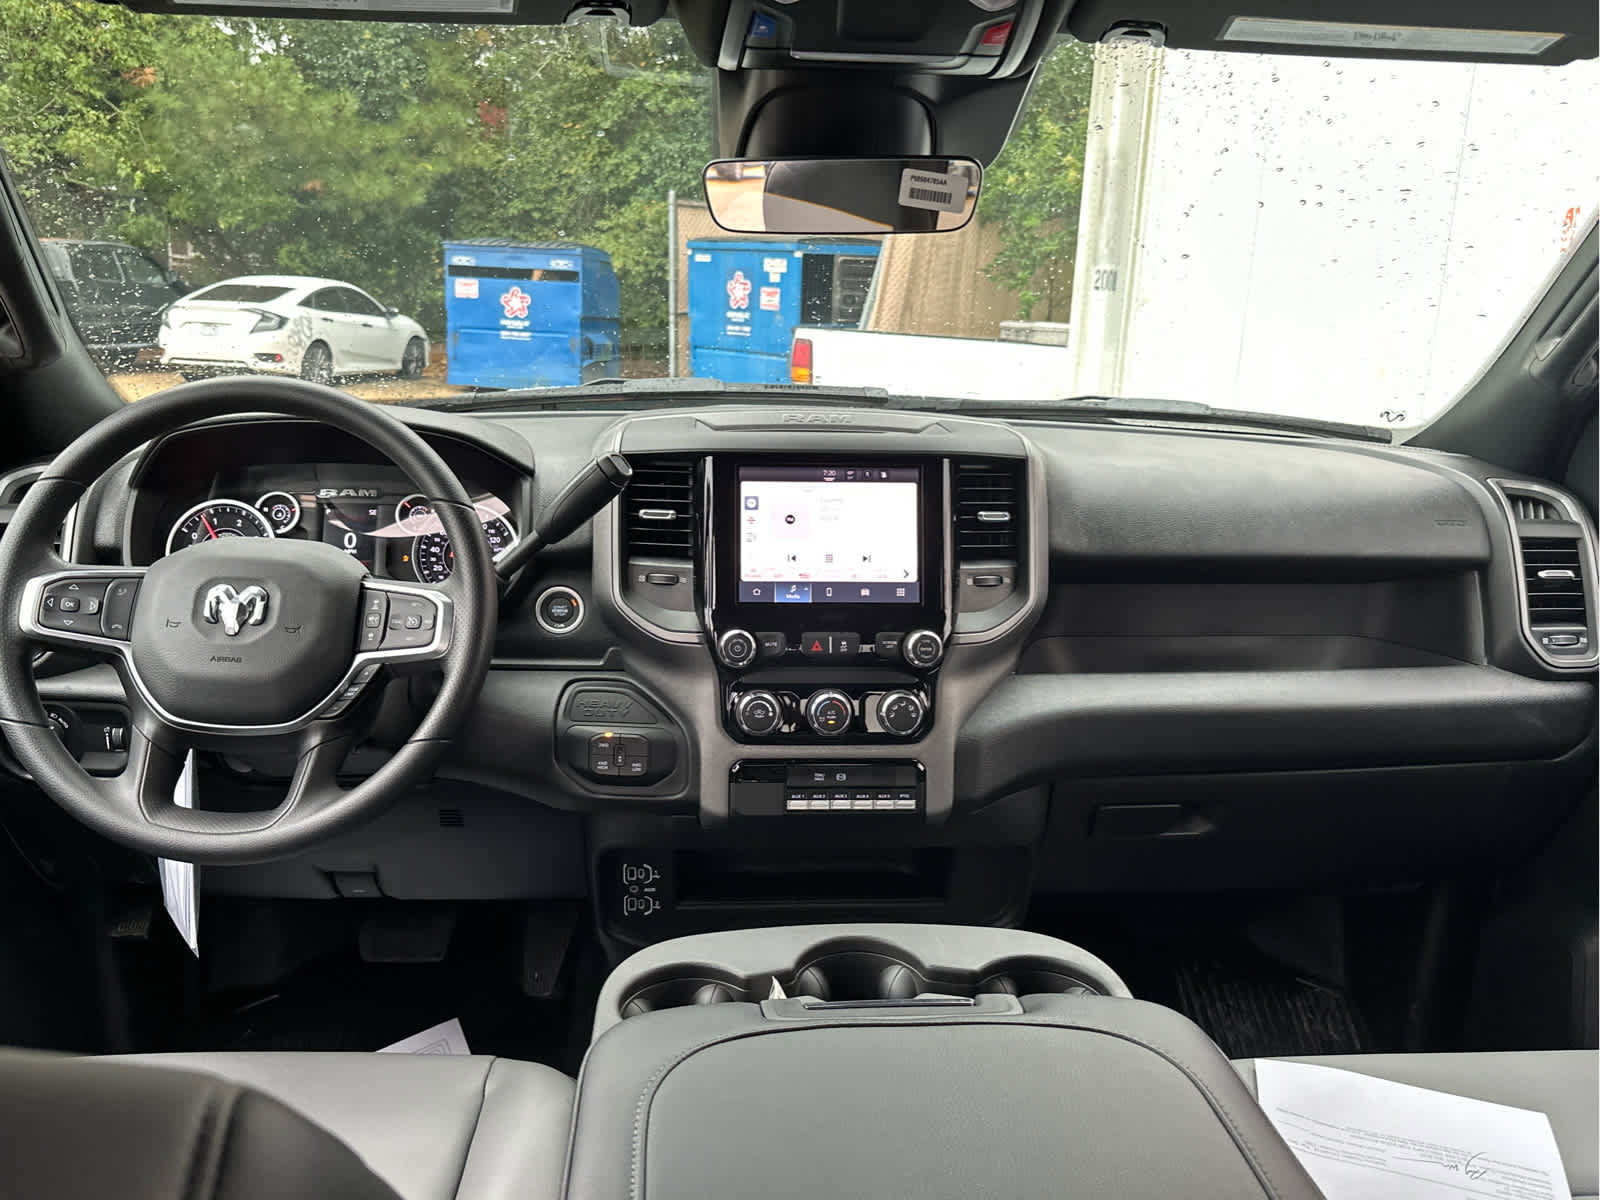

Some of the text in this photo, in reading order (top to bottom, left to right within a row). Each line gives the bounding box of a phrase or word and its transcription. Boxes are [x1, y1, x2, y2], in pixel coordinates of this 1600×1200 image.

[782, 413, 857, 424] RAM
[320, 488, 377, 498] RAM
[235, 519, 242, 527] 2
[343, 532, 357, 549] 0
[433, 564, 444, 572] 20
